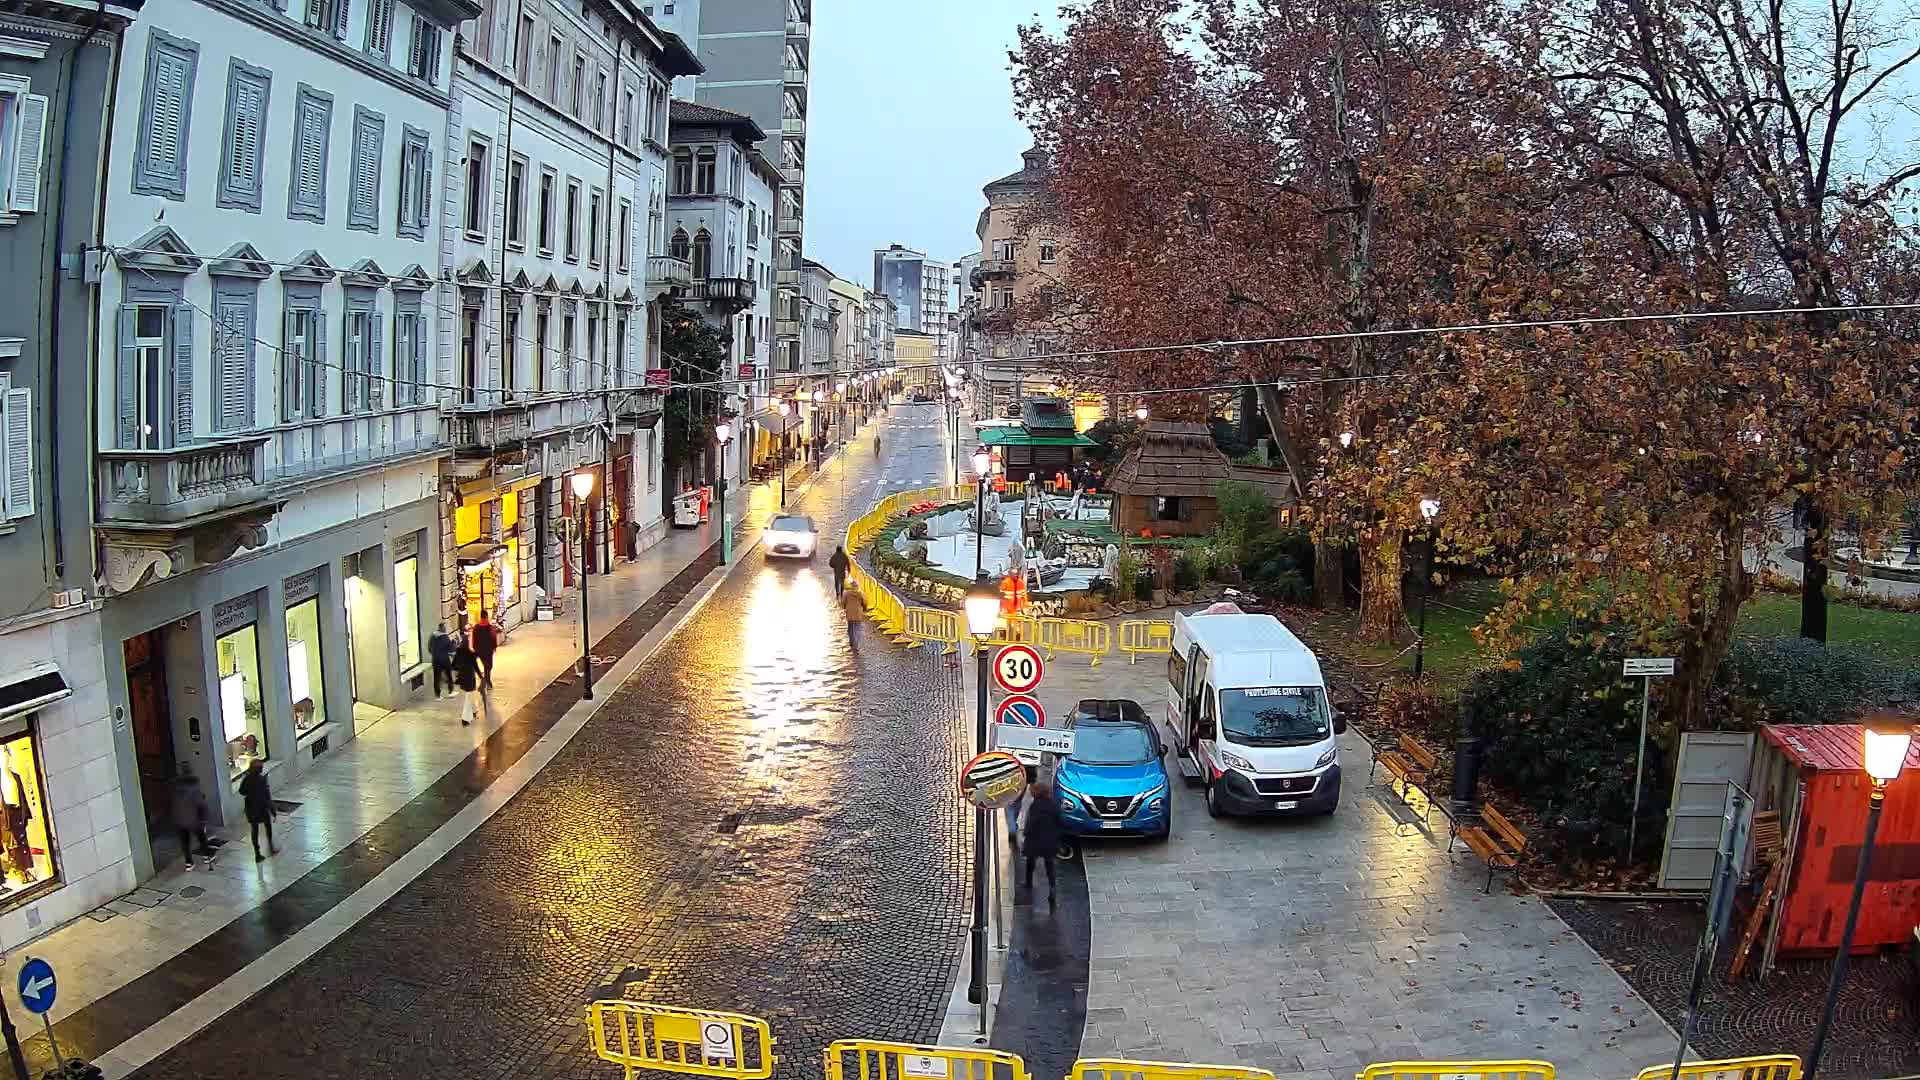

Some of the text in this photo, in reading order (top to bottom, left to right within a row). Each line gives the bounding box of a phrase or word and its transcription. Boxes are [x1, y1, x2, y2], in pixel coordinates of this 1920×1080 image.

[1005, 658, 1033, 680] 30
[1244, 687, 1302, 697] PROTEZIONE CIVILE
[1038, 737, 1070, 750] Dante
